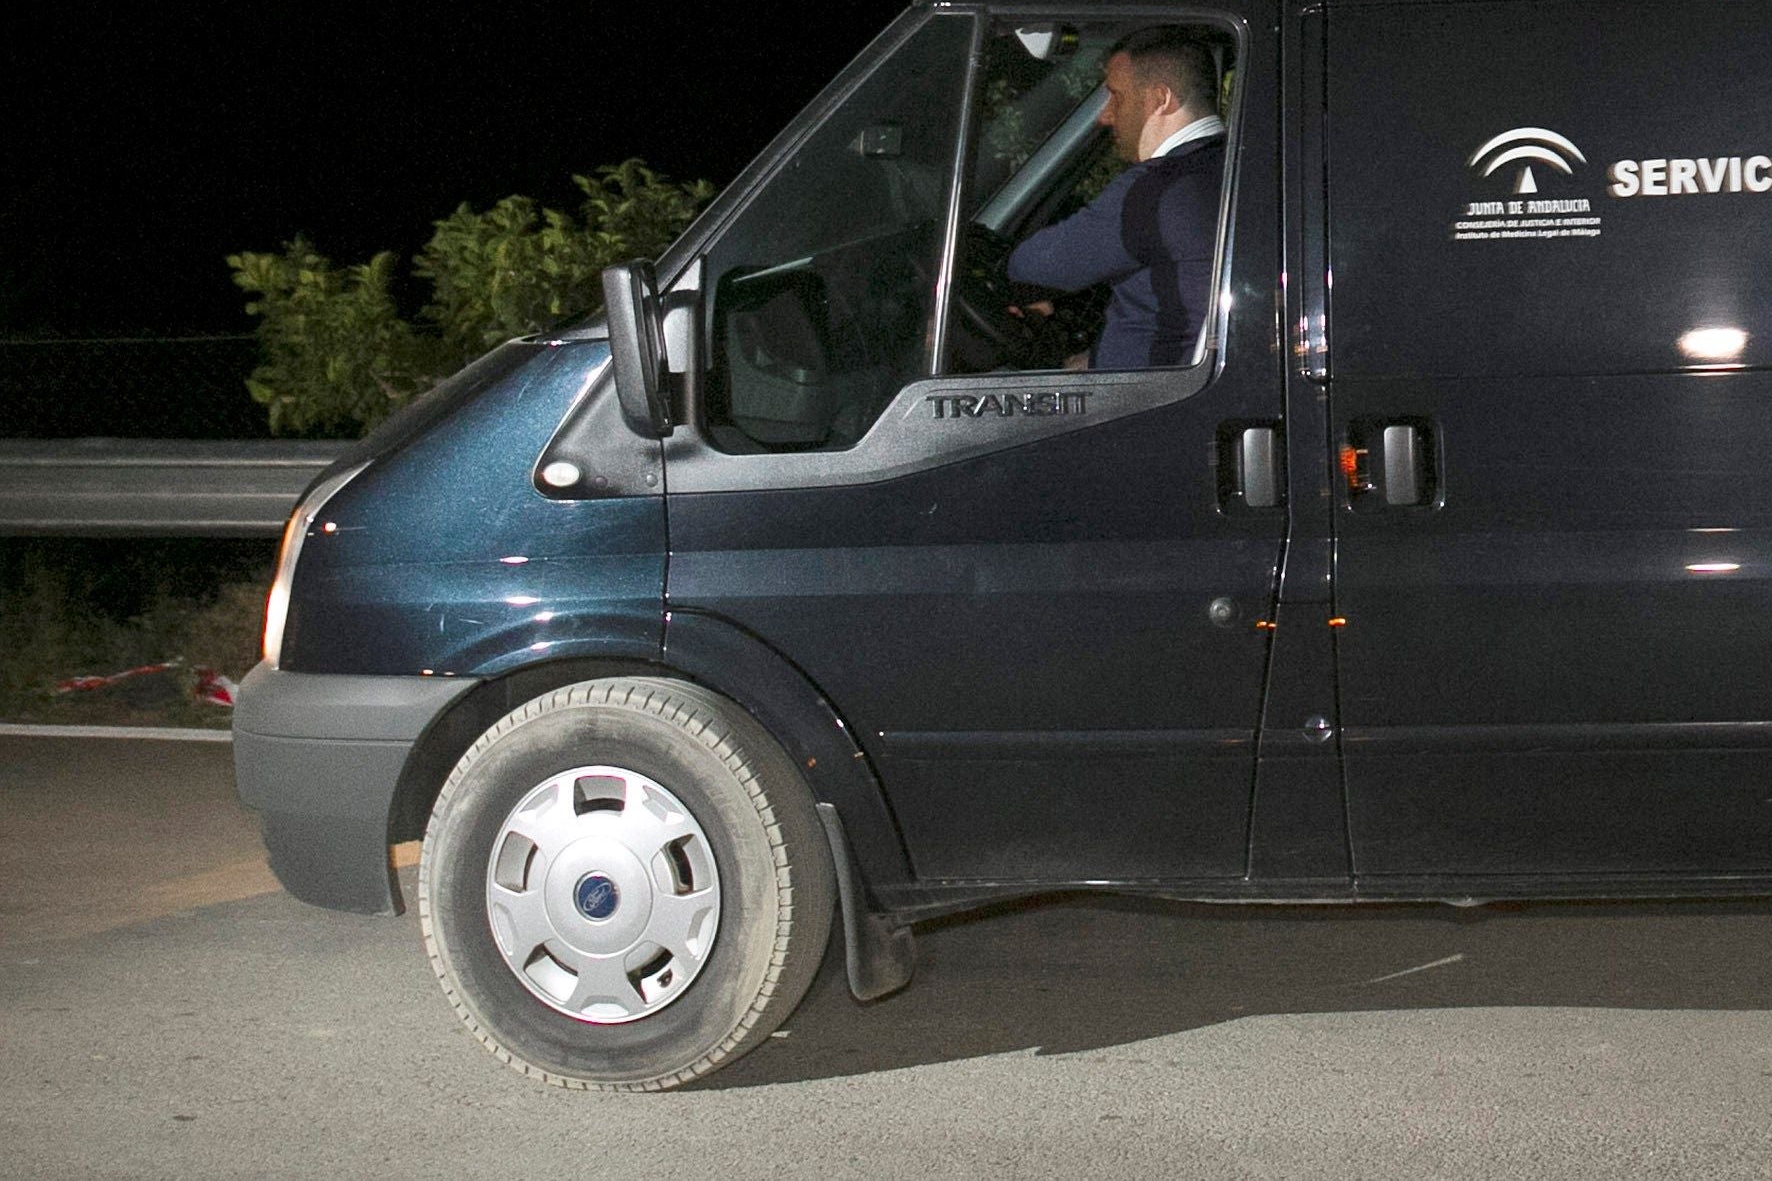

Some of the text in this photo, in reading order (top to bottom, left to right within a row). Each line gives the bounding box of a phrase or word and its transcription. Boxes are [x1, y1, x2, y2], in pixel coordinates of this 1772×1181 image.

[1466, 201, 1504, 216] JUNTA
[1508, 201, 1523, 214] DE
[925, 391, 1093, 419] TRANSIT
[585, 884, 609, 909] Ford
